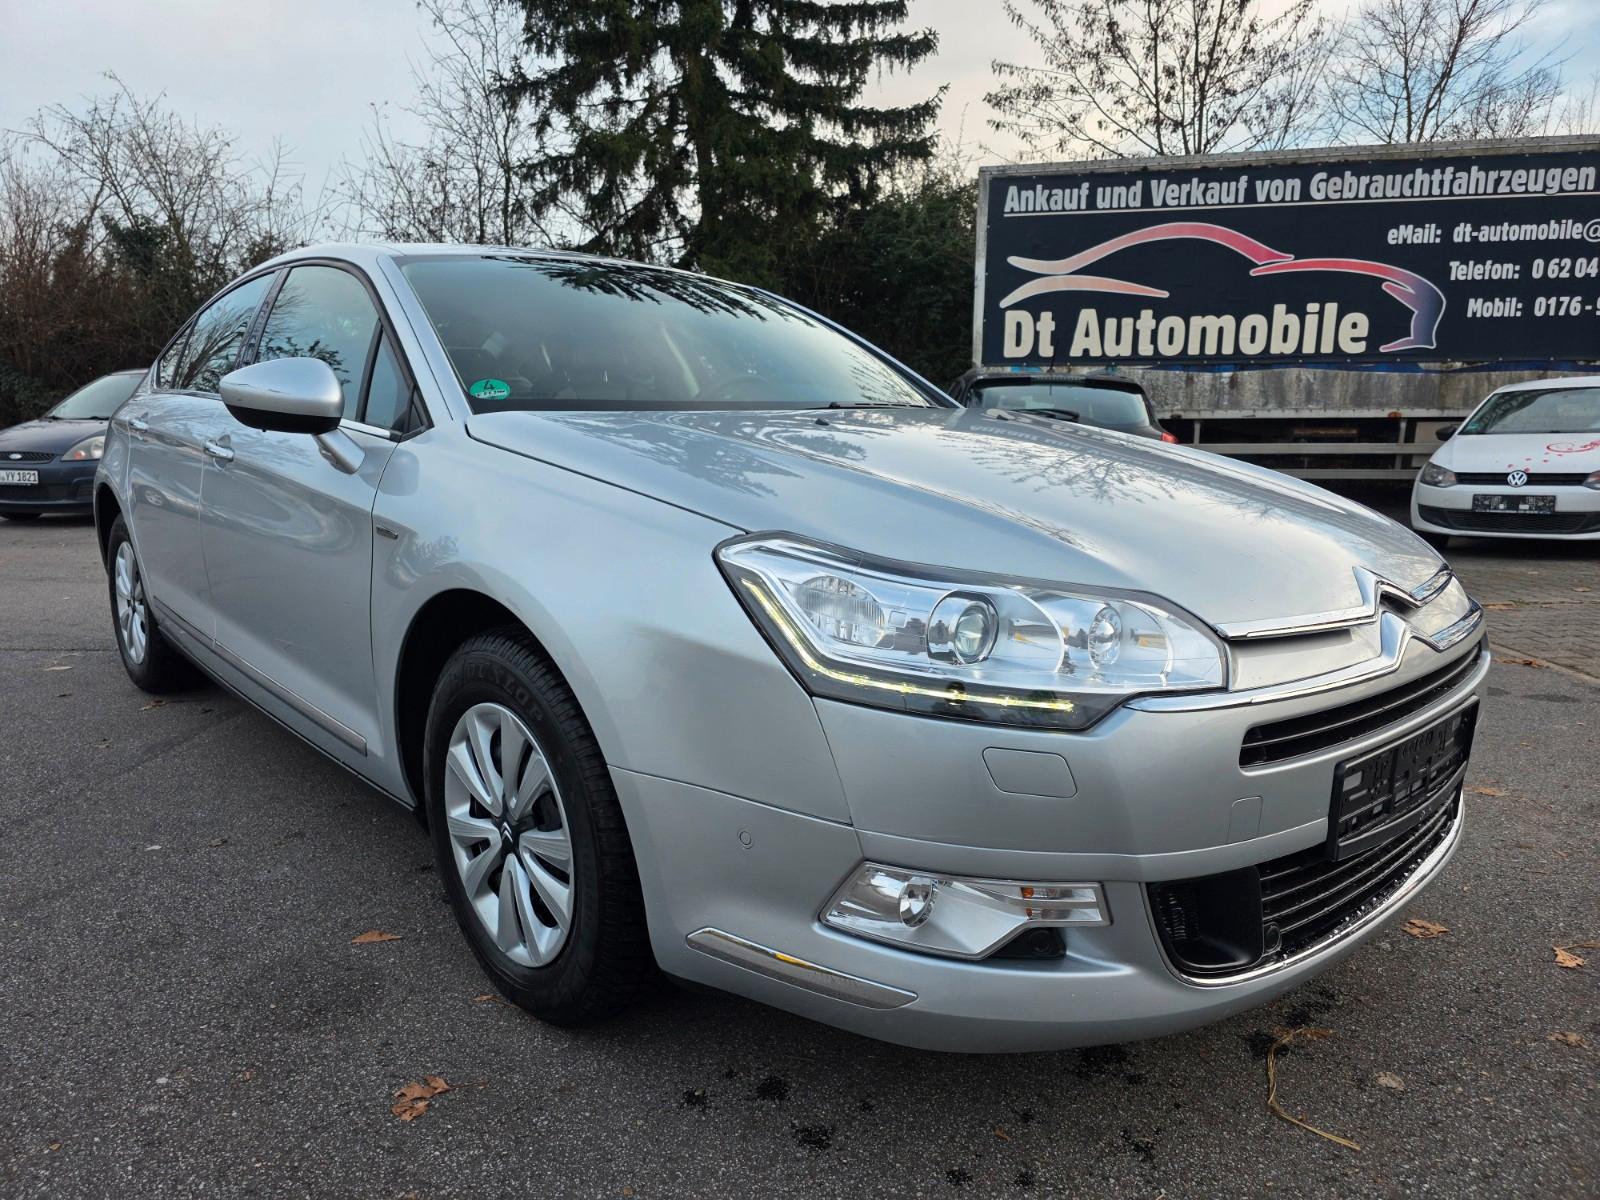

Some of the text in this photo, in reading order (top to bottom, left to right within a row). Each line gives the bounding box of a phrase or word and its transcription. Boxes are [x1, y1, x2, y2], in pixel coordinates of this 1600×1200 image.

[1004, 166, 1596, 212] Ankauf und Verkauf von Gebrauchtfahrzeugen
[1387, 223, 1442, 245] eMail:
[1449, 260, 1520, 281] Telefon:
[1466, 297, 1523, 318] Mobil:
[1534, 296, 1582, 317] 0176
[1003, 302, 1370, 358] Dt Automobile
[17, 472, 37, 482] 1821
